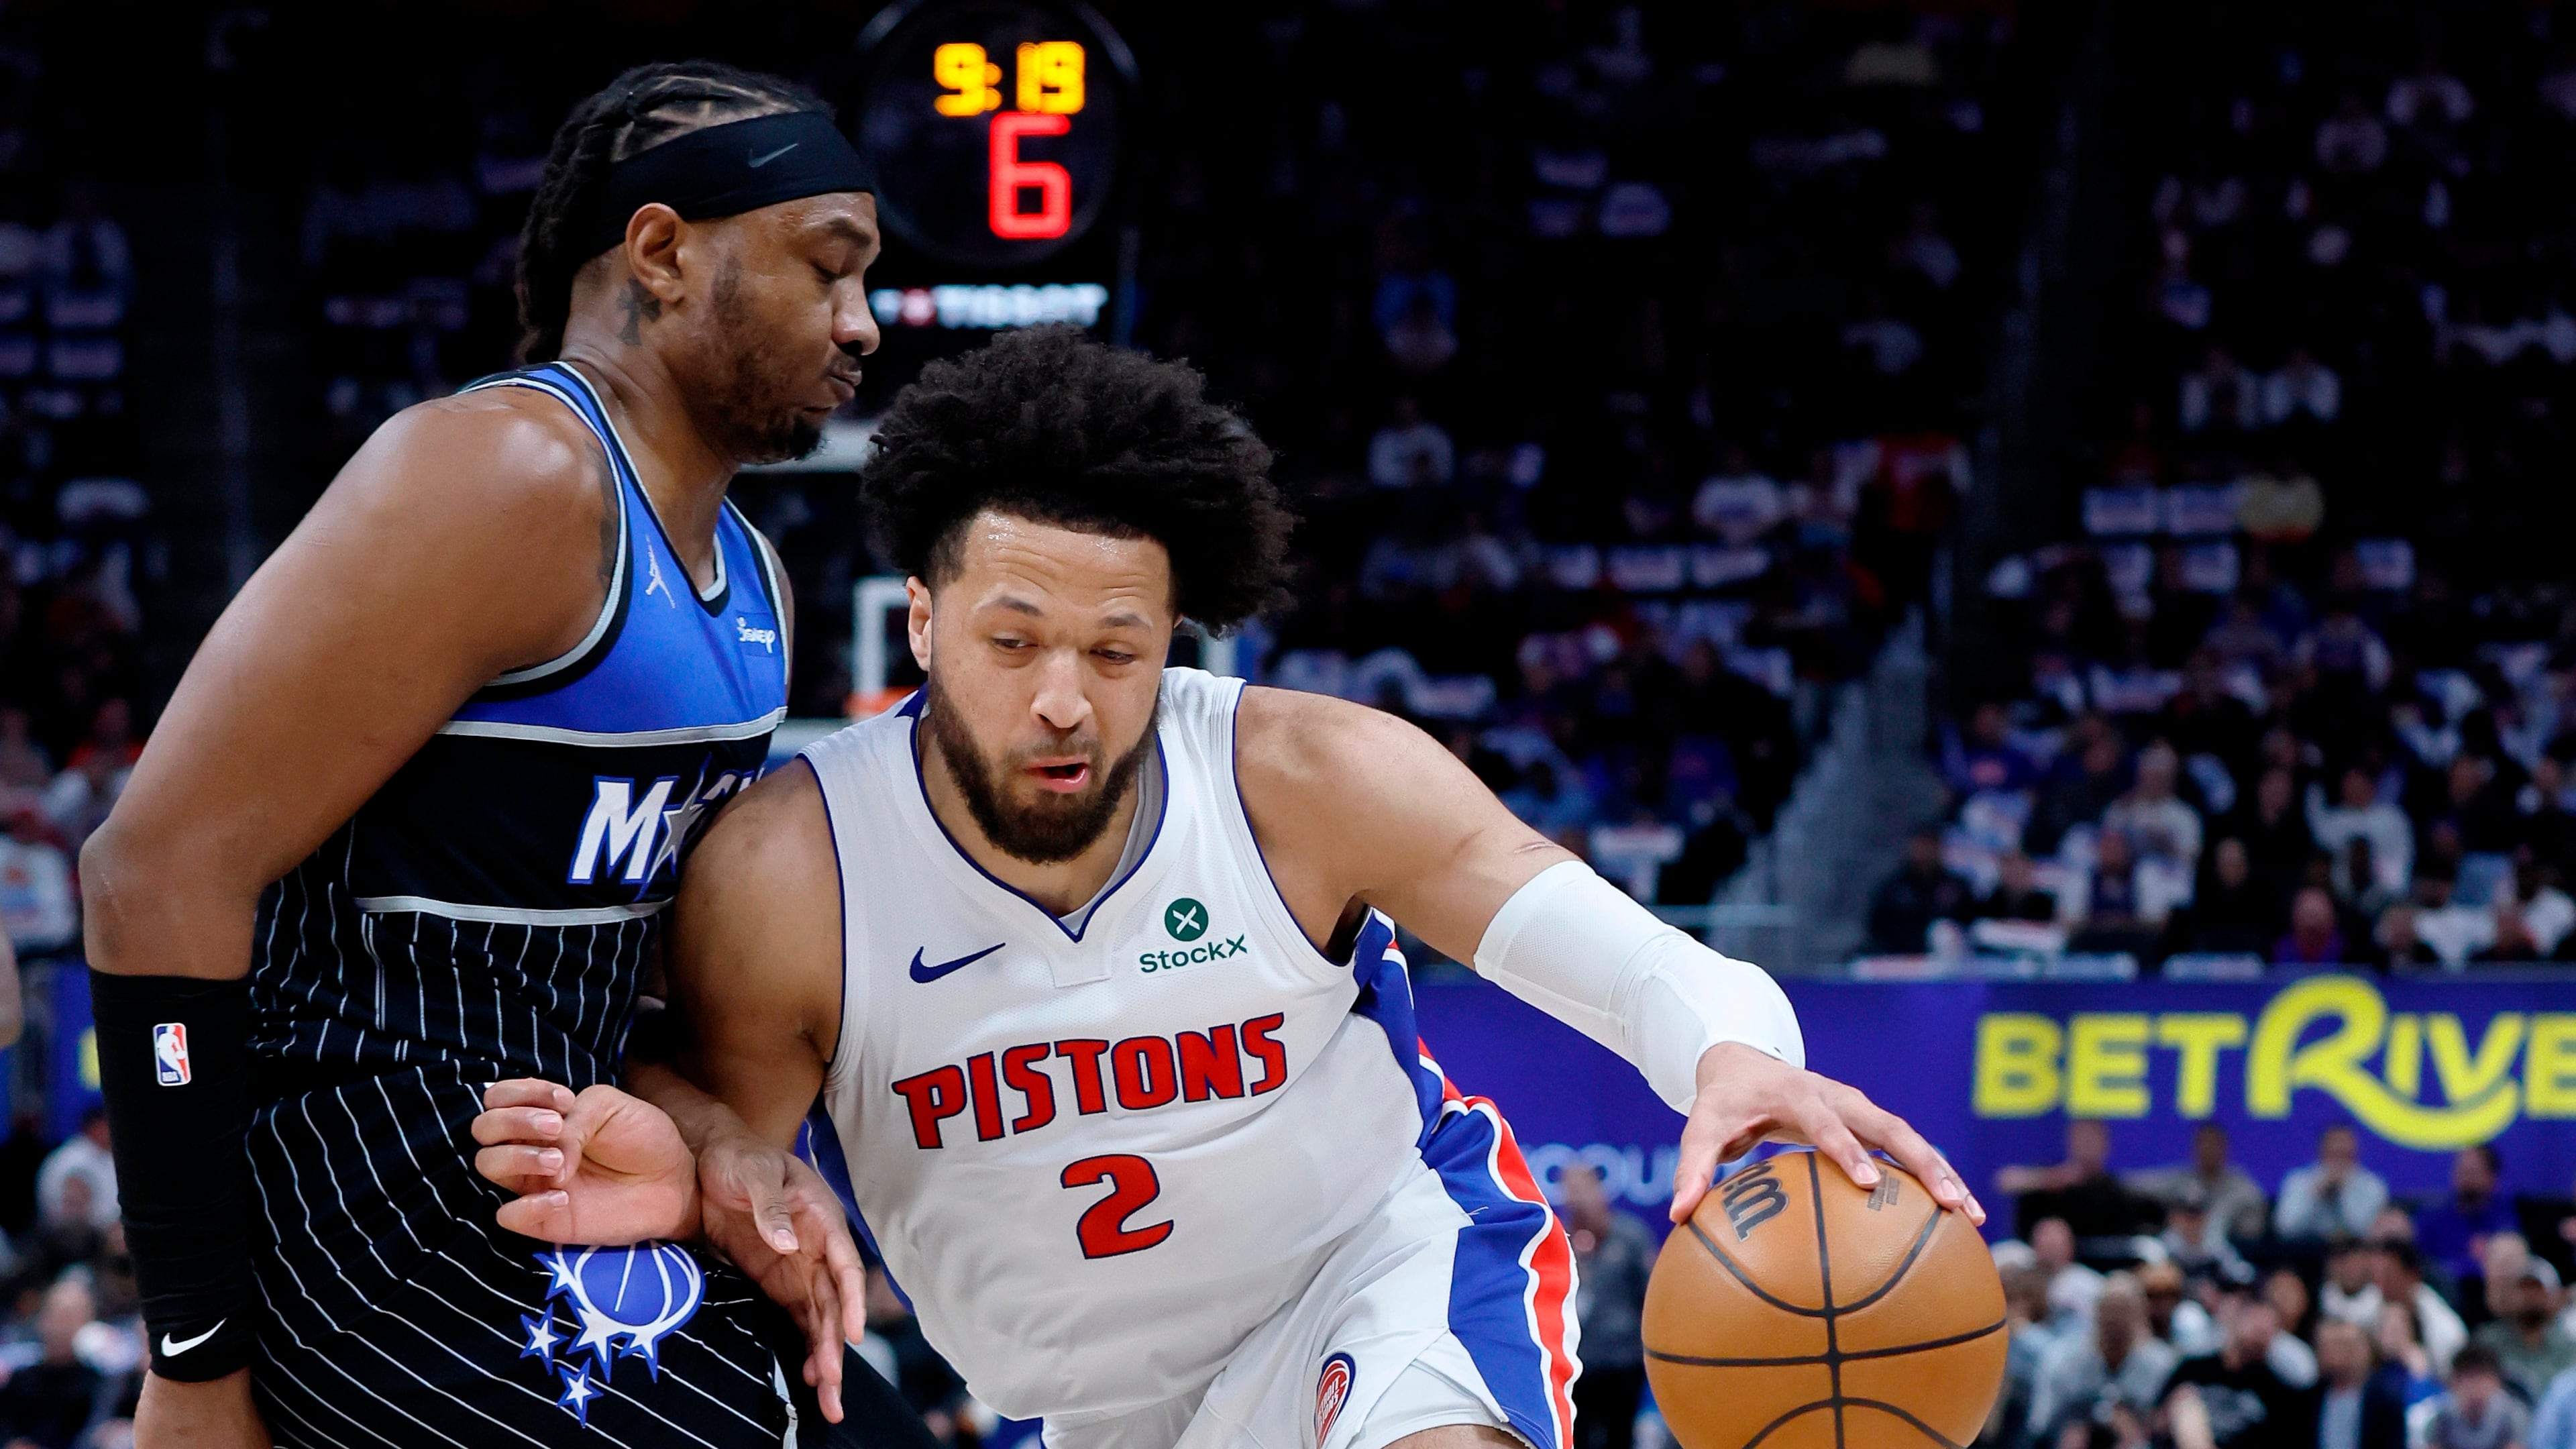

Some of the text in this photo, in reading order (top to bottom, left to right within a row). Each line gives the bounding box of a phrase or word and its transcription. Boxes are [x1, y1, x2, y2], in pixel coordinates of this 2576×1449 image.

[934, 41, 1085, 117] 9:19
[989, 111, 1072, 239] 6
[1139, 933, 1248, 973] StockX
[892, 1012, 1288, 1149] PISTONS
[1060, 1154, 1174, 1260] 2
